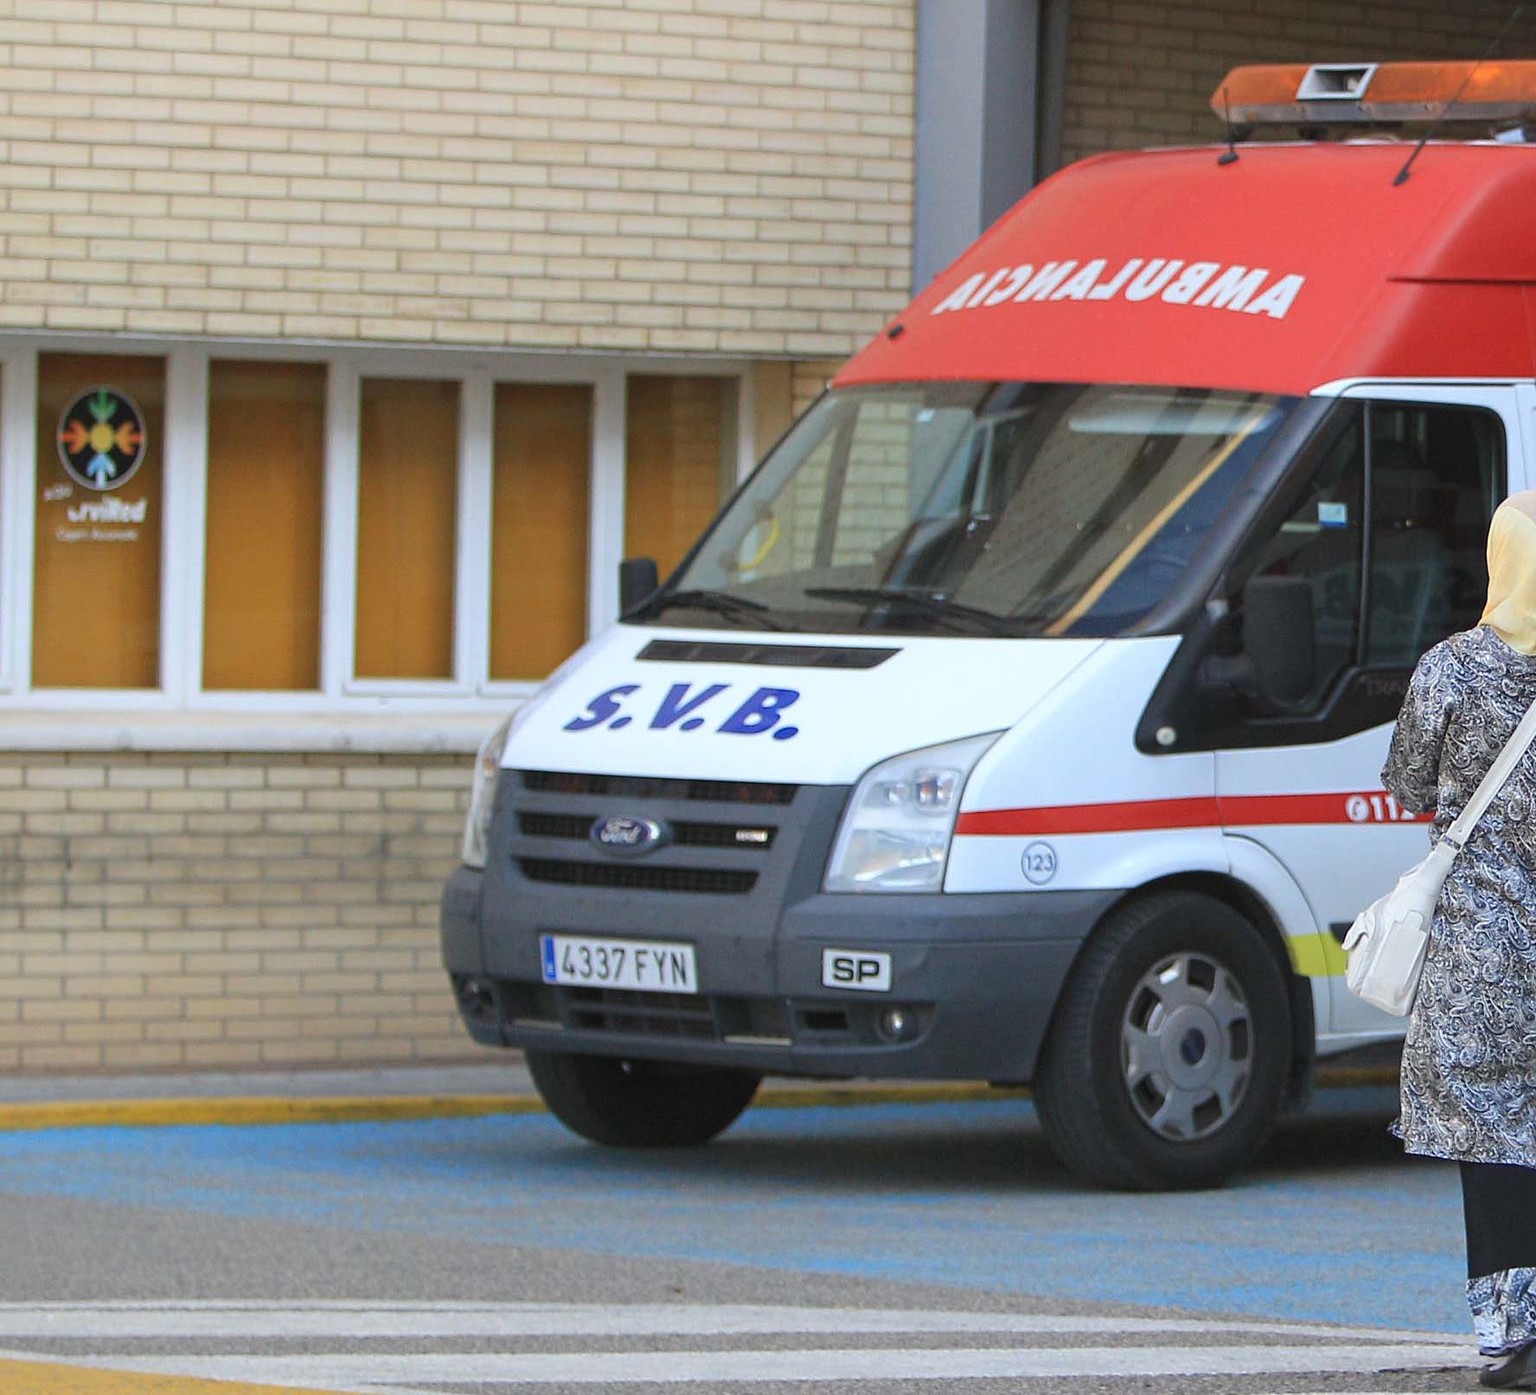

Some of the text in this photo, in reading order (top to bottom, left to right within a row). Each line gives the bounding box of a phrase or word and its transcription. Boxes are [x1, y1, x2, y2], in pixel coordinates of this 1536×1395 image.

[561, 684, 801, 741] S.V.B.
[1025, 853, 1054, 871] 123
[561, 945, 626, 981] 4337
[635, 949, 688, 985] FYN
[832, 957, 881, 983] SP
